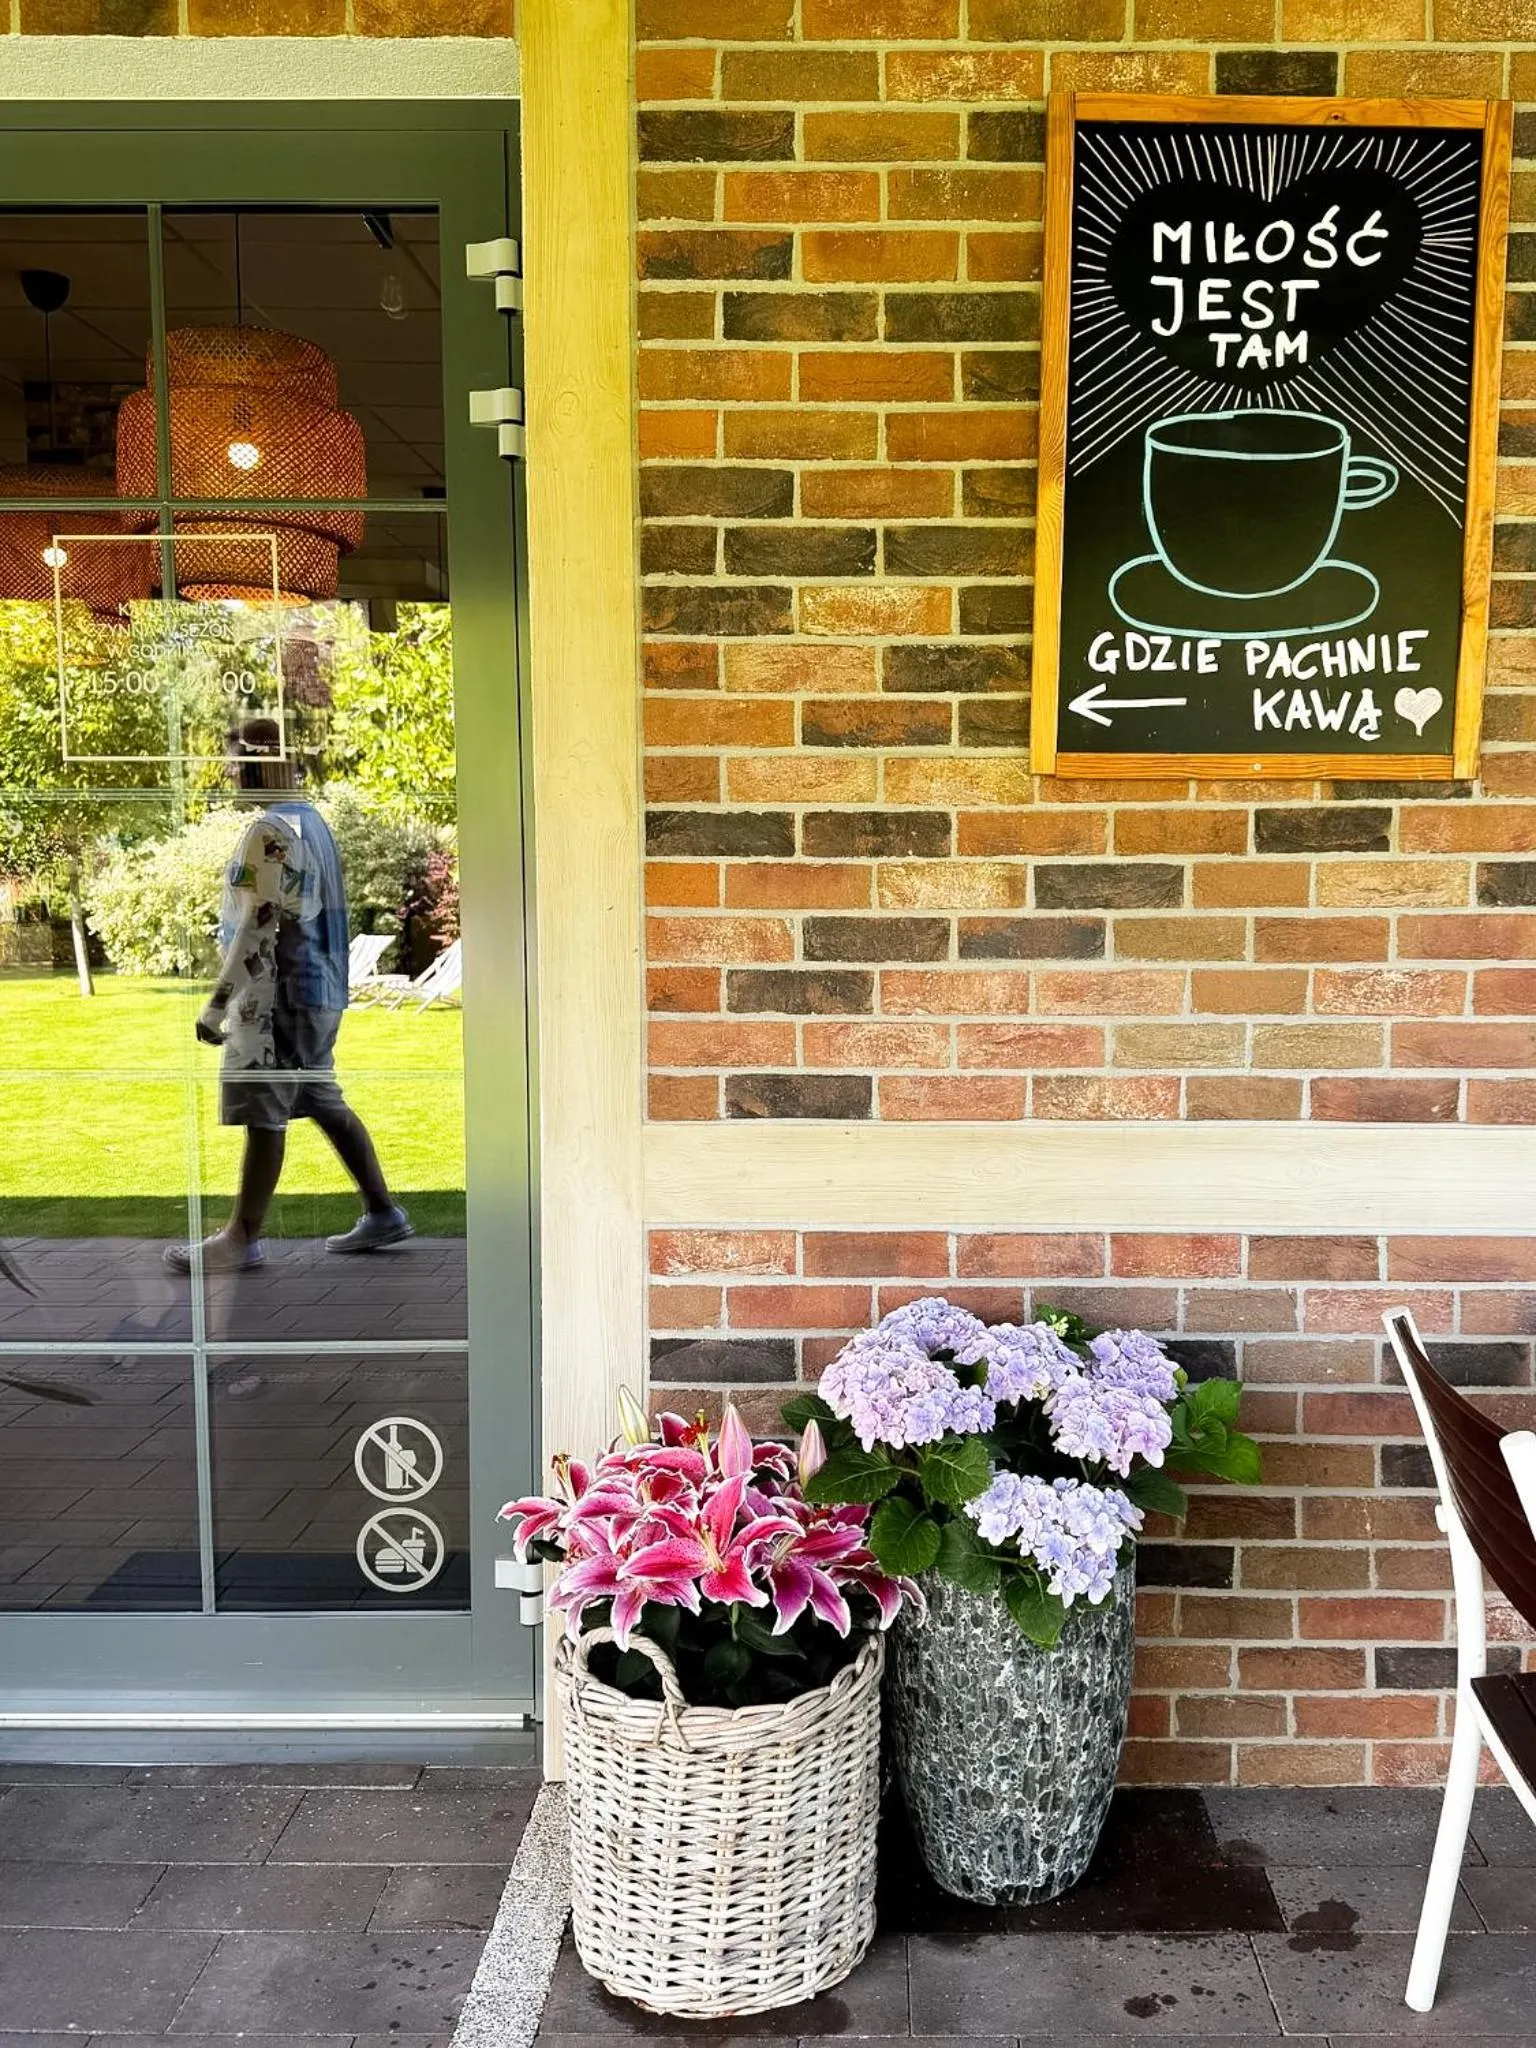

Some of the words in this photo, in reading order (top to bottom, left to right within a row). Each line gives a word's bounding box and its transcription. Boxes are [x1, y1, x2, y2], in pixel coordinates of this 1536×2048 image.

[1152, 204, 1390, 269] MIŁOŚĆ
[1150, 276, 1321, 337] JEST
[1208, 330, 1309, 370] TAM
[1086, 630, 1223, 675] GDZIE
[1244, 629, 1430, 681] PACHNIE
[1252, 687, 1384, 742] KAWĄ
